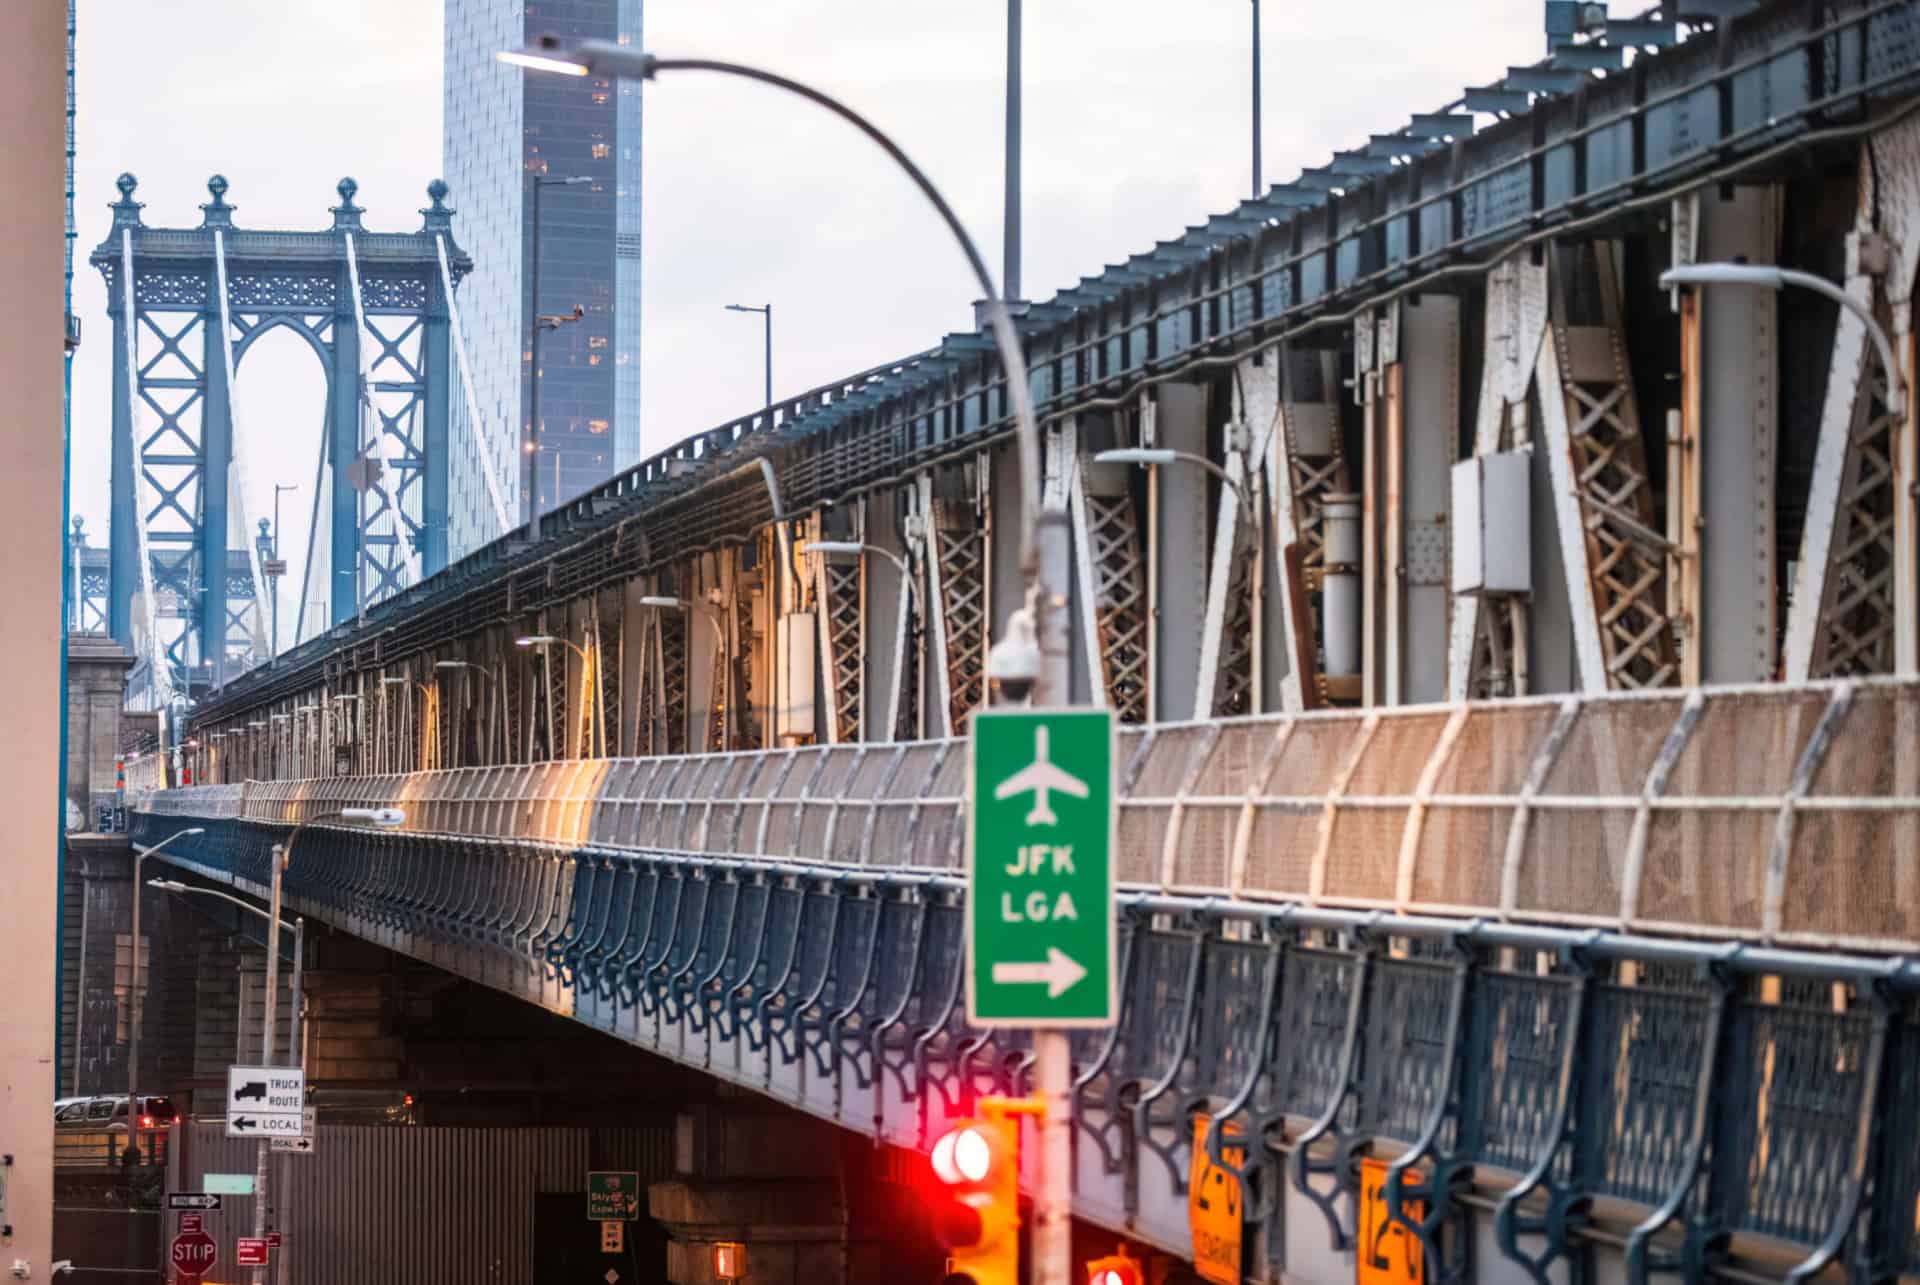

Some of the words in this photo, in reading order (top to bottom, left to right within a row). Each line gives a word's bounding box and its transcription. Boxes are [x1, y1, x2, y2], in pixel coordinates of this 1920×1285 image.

[1005, 844, 1076, 877] JFK
[1001, 891, 1079, 923] LGA
[270, 1079, 300, 1089] TRUCK
[269, 1096, 300, 1106] ROUTE
[263, 1119, 299, 1130] LOCAL
[174, 1243, 214, 1261] STOP
